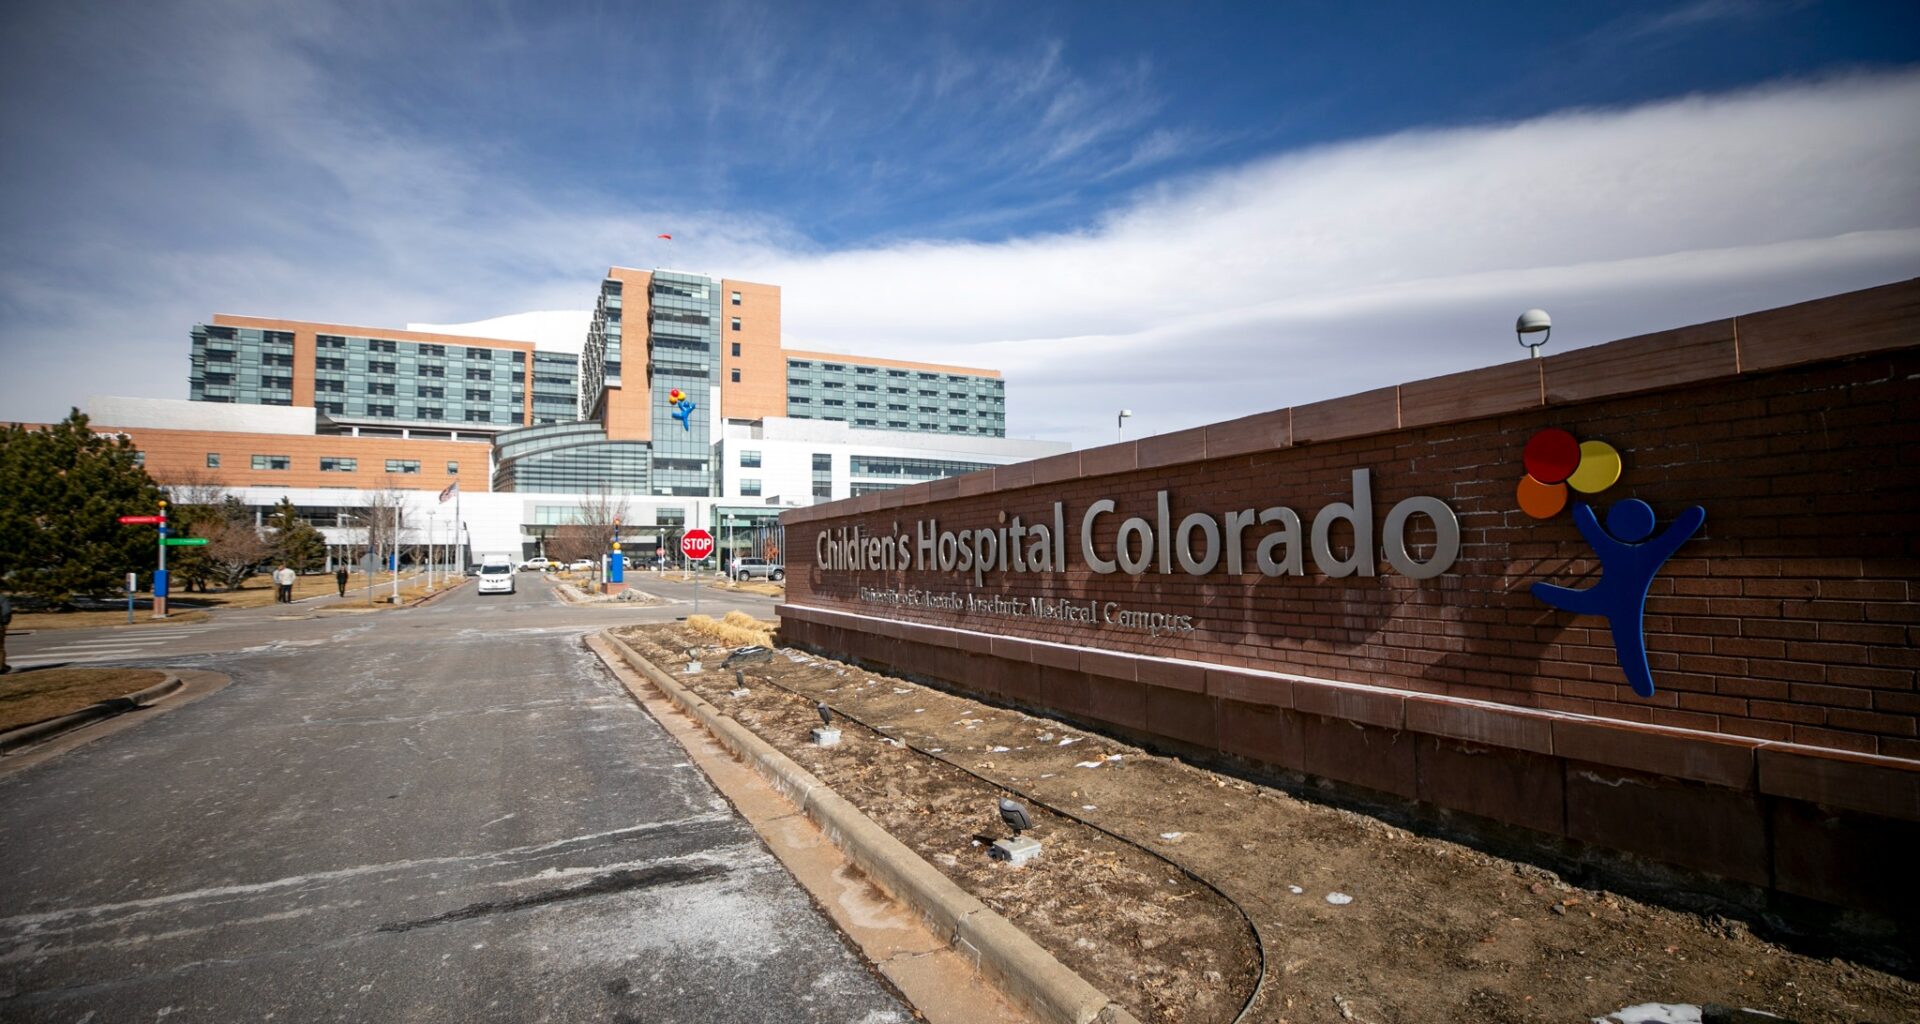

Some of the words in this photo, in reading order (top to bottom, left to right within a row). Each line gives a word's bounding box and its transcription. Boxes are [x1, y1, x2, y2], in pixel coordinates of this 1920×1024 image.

[683, 538, 711, 550] STOP
[816, 521, 911, 571] Children's
[917, 501, 1066, 588] Hospital
[1081, 468, 1461, 581] Colorado
[914, 590, 964, 609] Colorado
[1030, 597, 1099, 624] Medical
[1103, 601, 1195, 638] Campus
